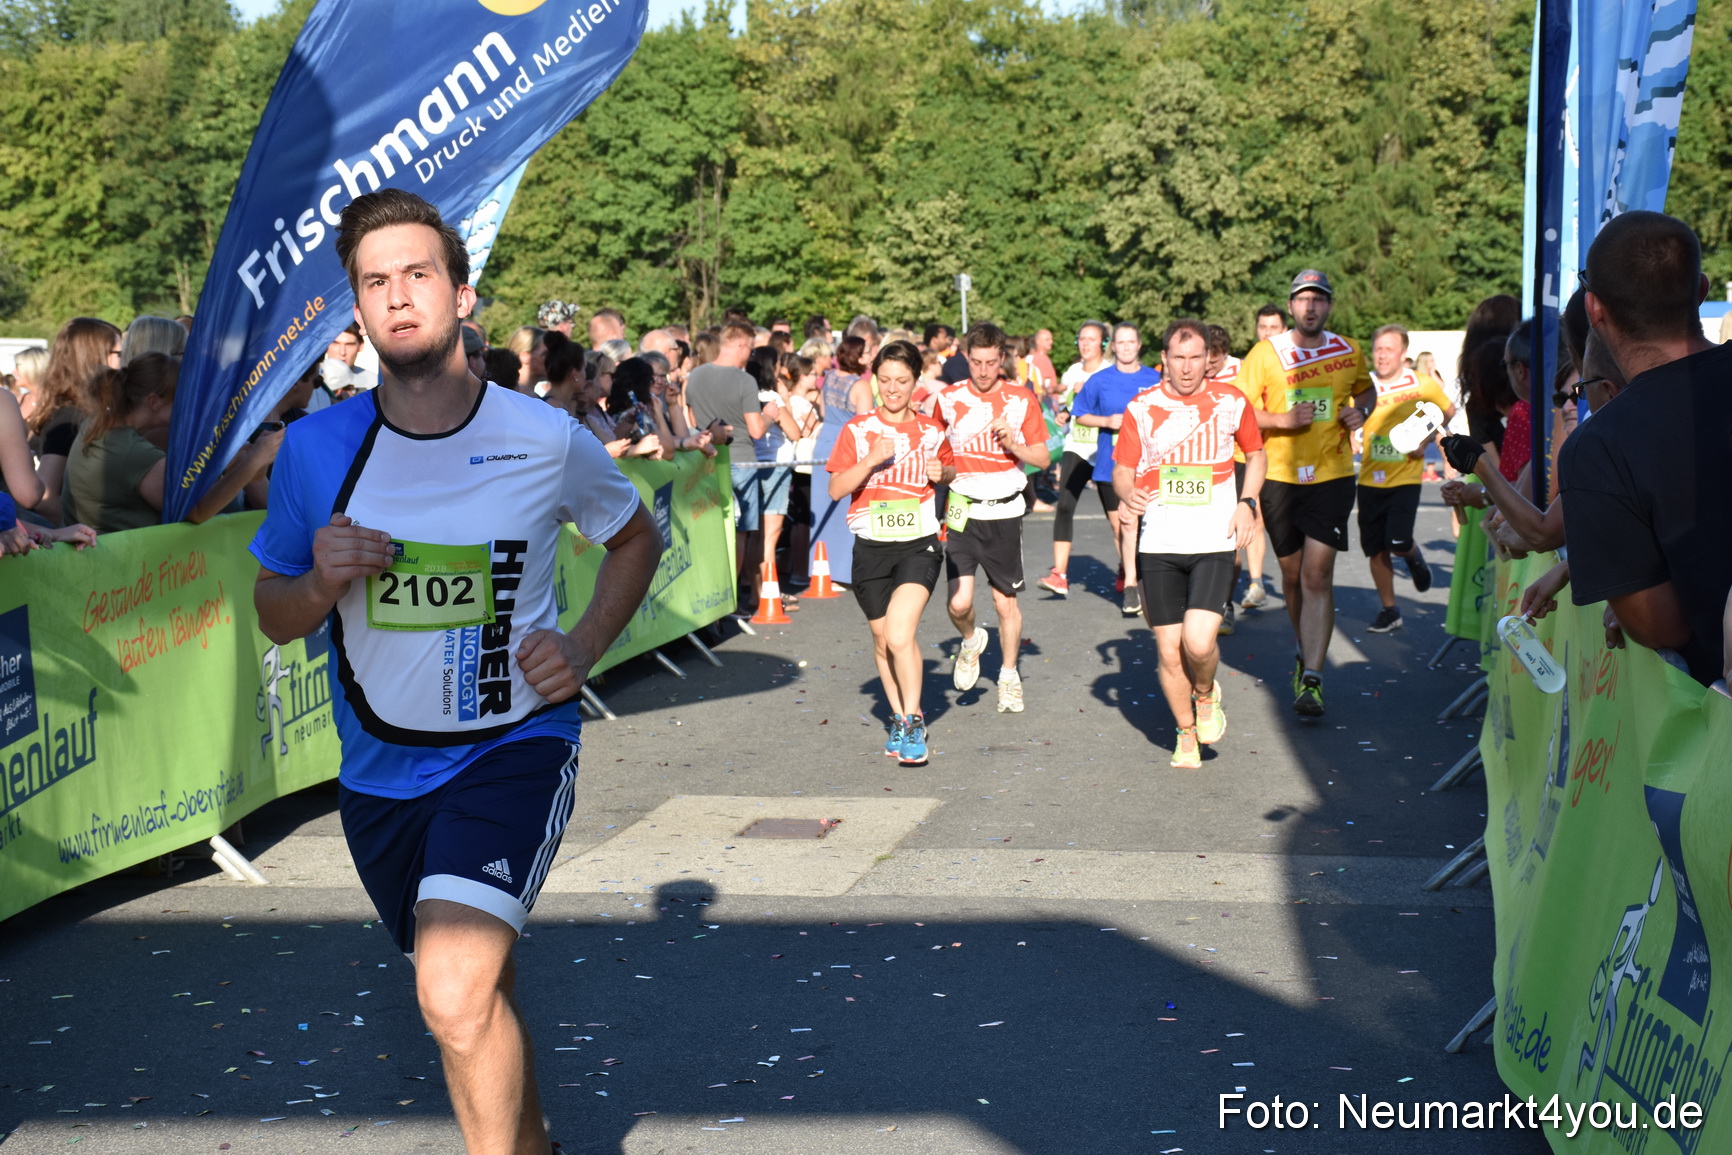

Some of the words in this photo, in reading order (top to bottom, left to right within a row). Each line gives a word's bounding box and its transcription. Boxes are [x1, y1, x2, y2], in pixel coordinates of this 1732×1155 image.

[414, 116, 487, 184] Druck
[485, 66, 534, 121] und
[237, 31, 517, 310] Frischmann
[181, 295, 326, 490] www.frischmann-net.de
[1286, 367, 1320, 386] MAX
[1323, 357, 1357, 374] BÖGL
[877, 512, 915, 528] 1862
[1166, 480, 1205, 495] 1836
[83, 560, 153, 633] Gesunde
[158, 549, 209, 596] Firmen
[379, 572, 476, 607] 2102
[424, 564, 447, 573] 2018
[116, 617, 169, 675] laufen
[169, 580, 231, 650] länger!
[477, 539, 528, 719] HUBER
[442, 668, 454, 716] Solutions
[460, 623, 479, 713] NOLOGY
[482, 866, 512, 883] adidas
